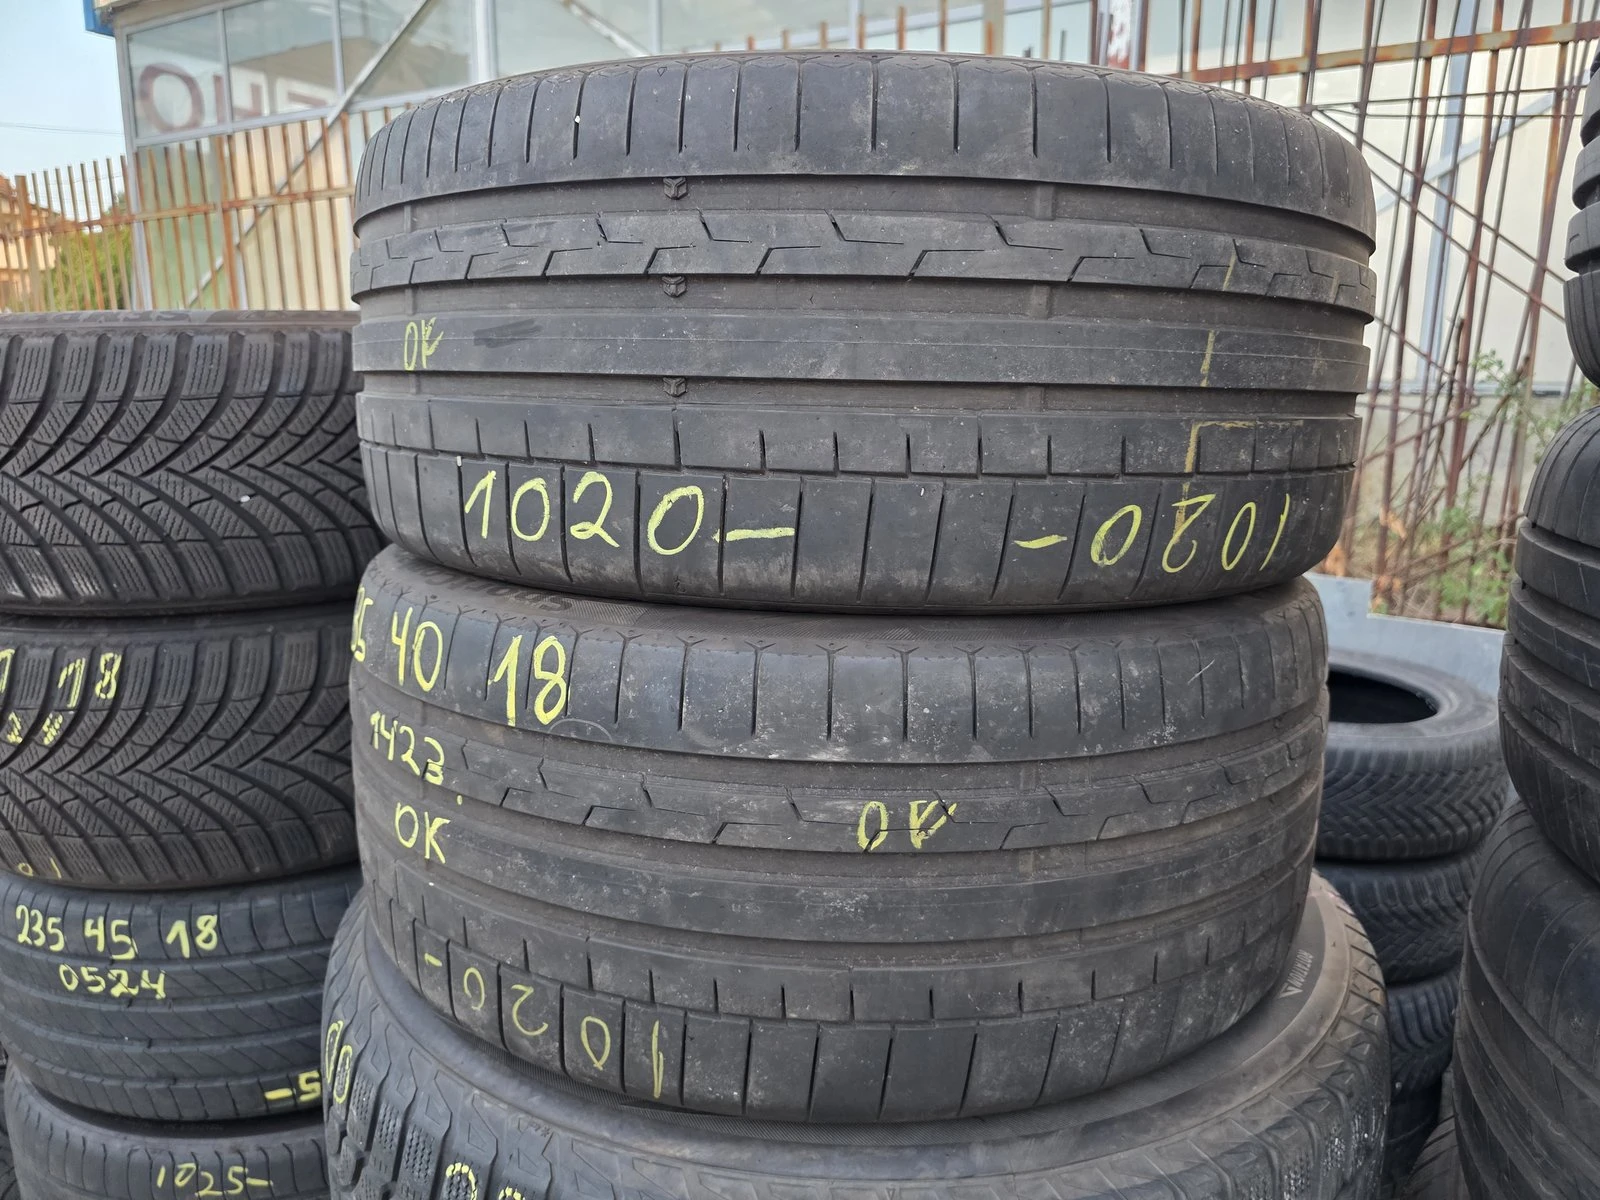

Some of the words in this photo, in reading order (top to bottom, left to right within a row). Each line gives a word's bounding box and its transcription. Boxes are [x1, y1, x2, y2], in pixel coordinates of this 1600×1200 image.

[403, 316, 444, 371] OK
[58, 652, 122, 708] 18
[391, 607, 444, 692] 40
[488, 634, 570, 727] 18
[370, 711, 444, 785] 1423
[394, 802, 451, 864] OK
[16, 904, 65, 952] 235
[83, 915, 139, 960] 45
[165, 914, 218, 959] 18
[59, 962, 167, 999] 0524
